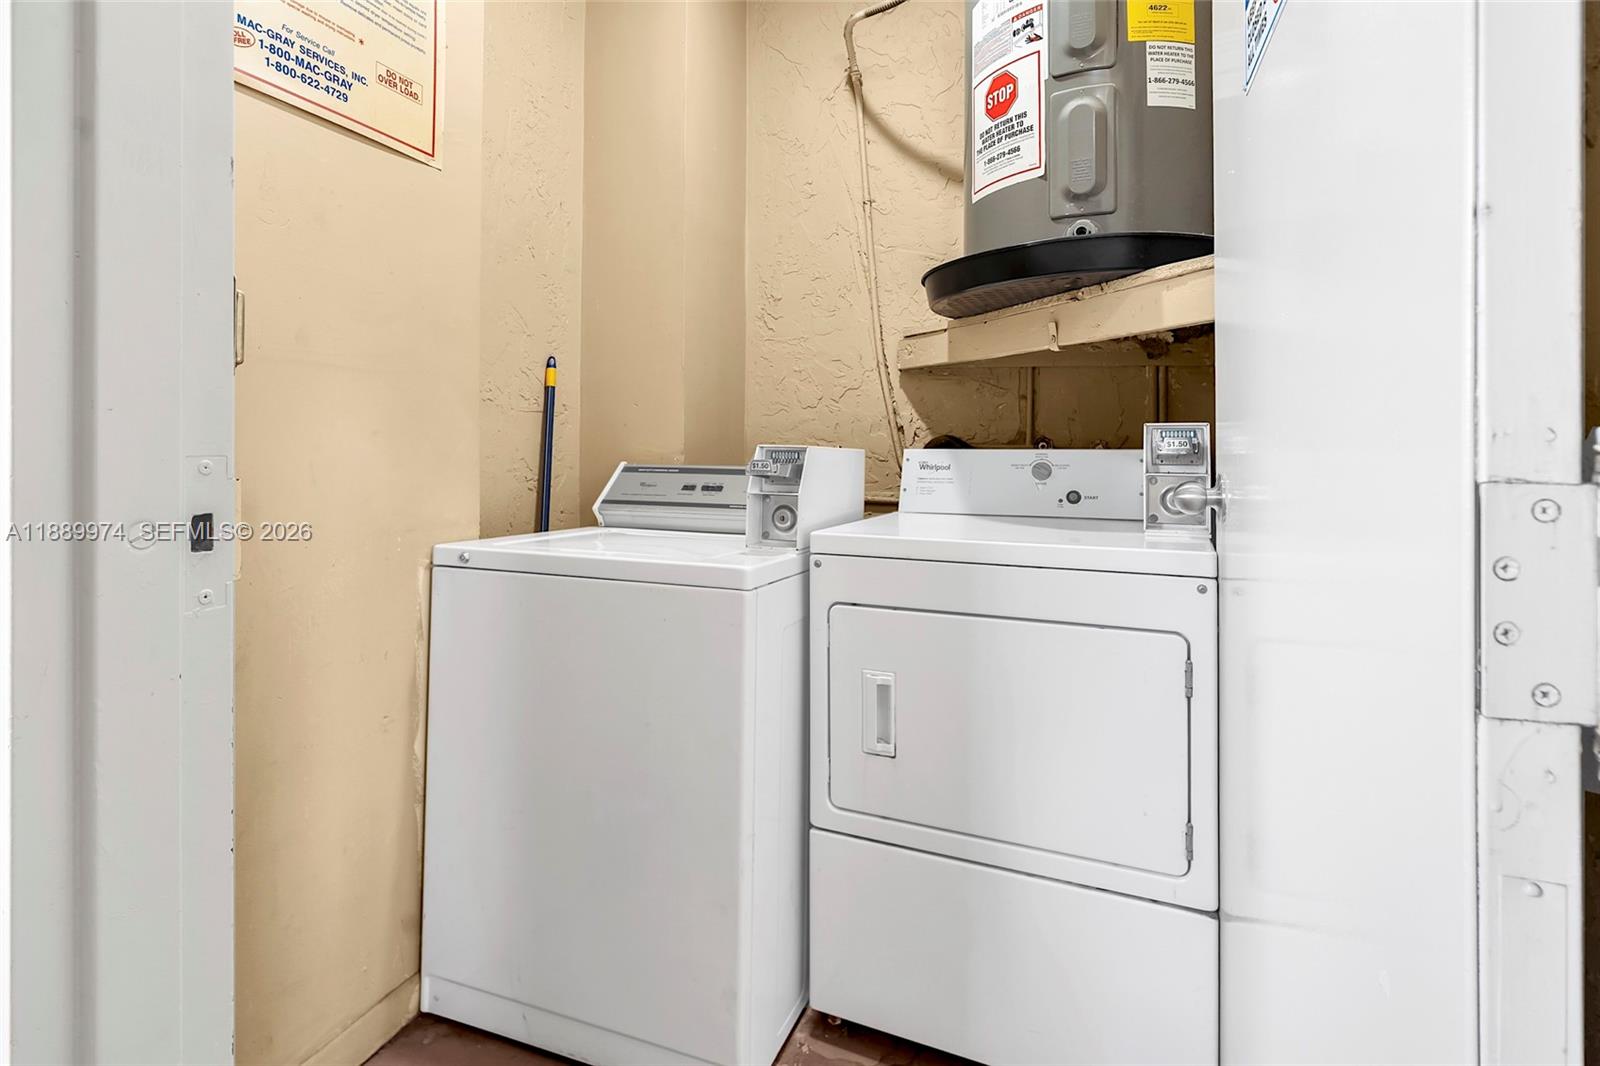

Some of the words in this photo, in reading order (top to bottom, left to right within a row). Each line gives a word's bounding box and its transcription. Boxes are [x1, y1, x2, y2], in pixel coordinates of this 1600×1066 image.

[236, 14, 296, 49] MAC-GRAY
[299, 44, 348, 78] SERVICES,
[351, 70, 369, 87] INC.
[281, 24, 293, 34] For
[296, 32, 321, 50] Service
[322, 45, 336, 56] Call
[258, 39, 354, 92] 1-800-MAC-GRAY
[264, 56, 349, 103] 1-800-622-4729
[386, 69, 396, 80] DO
[398, 75, 414, 90] NOT
[377, 73, 398, 90] OVER
[400, 84, 421, 102] LOAD.
[1148, 76, 1195, 87] 1-866-279-4566
[986, 83, 1015, 111] STOP
[979, 131, 985, 140] DO
[985, 126, 994, 136] NOT
[994, 116, 1014, 131] RETURN
[1014, 110, 1028, 121] THIS
[982, 133, 996, 146] WATER
[996, 124, 1015, 138] HEATER
[983, 140, 996, 152] PLACE
[997, 136, 1004, 144] OF
[1004, 124, 1034, 141] PURCHASE
[918, 464, 952, 472] Whirlpool
